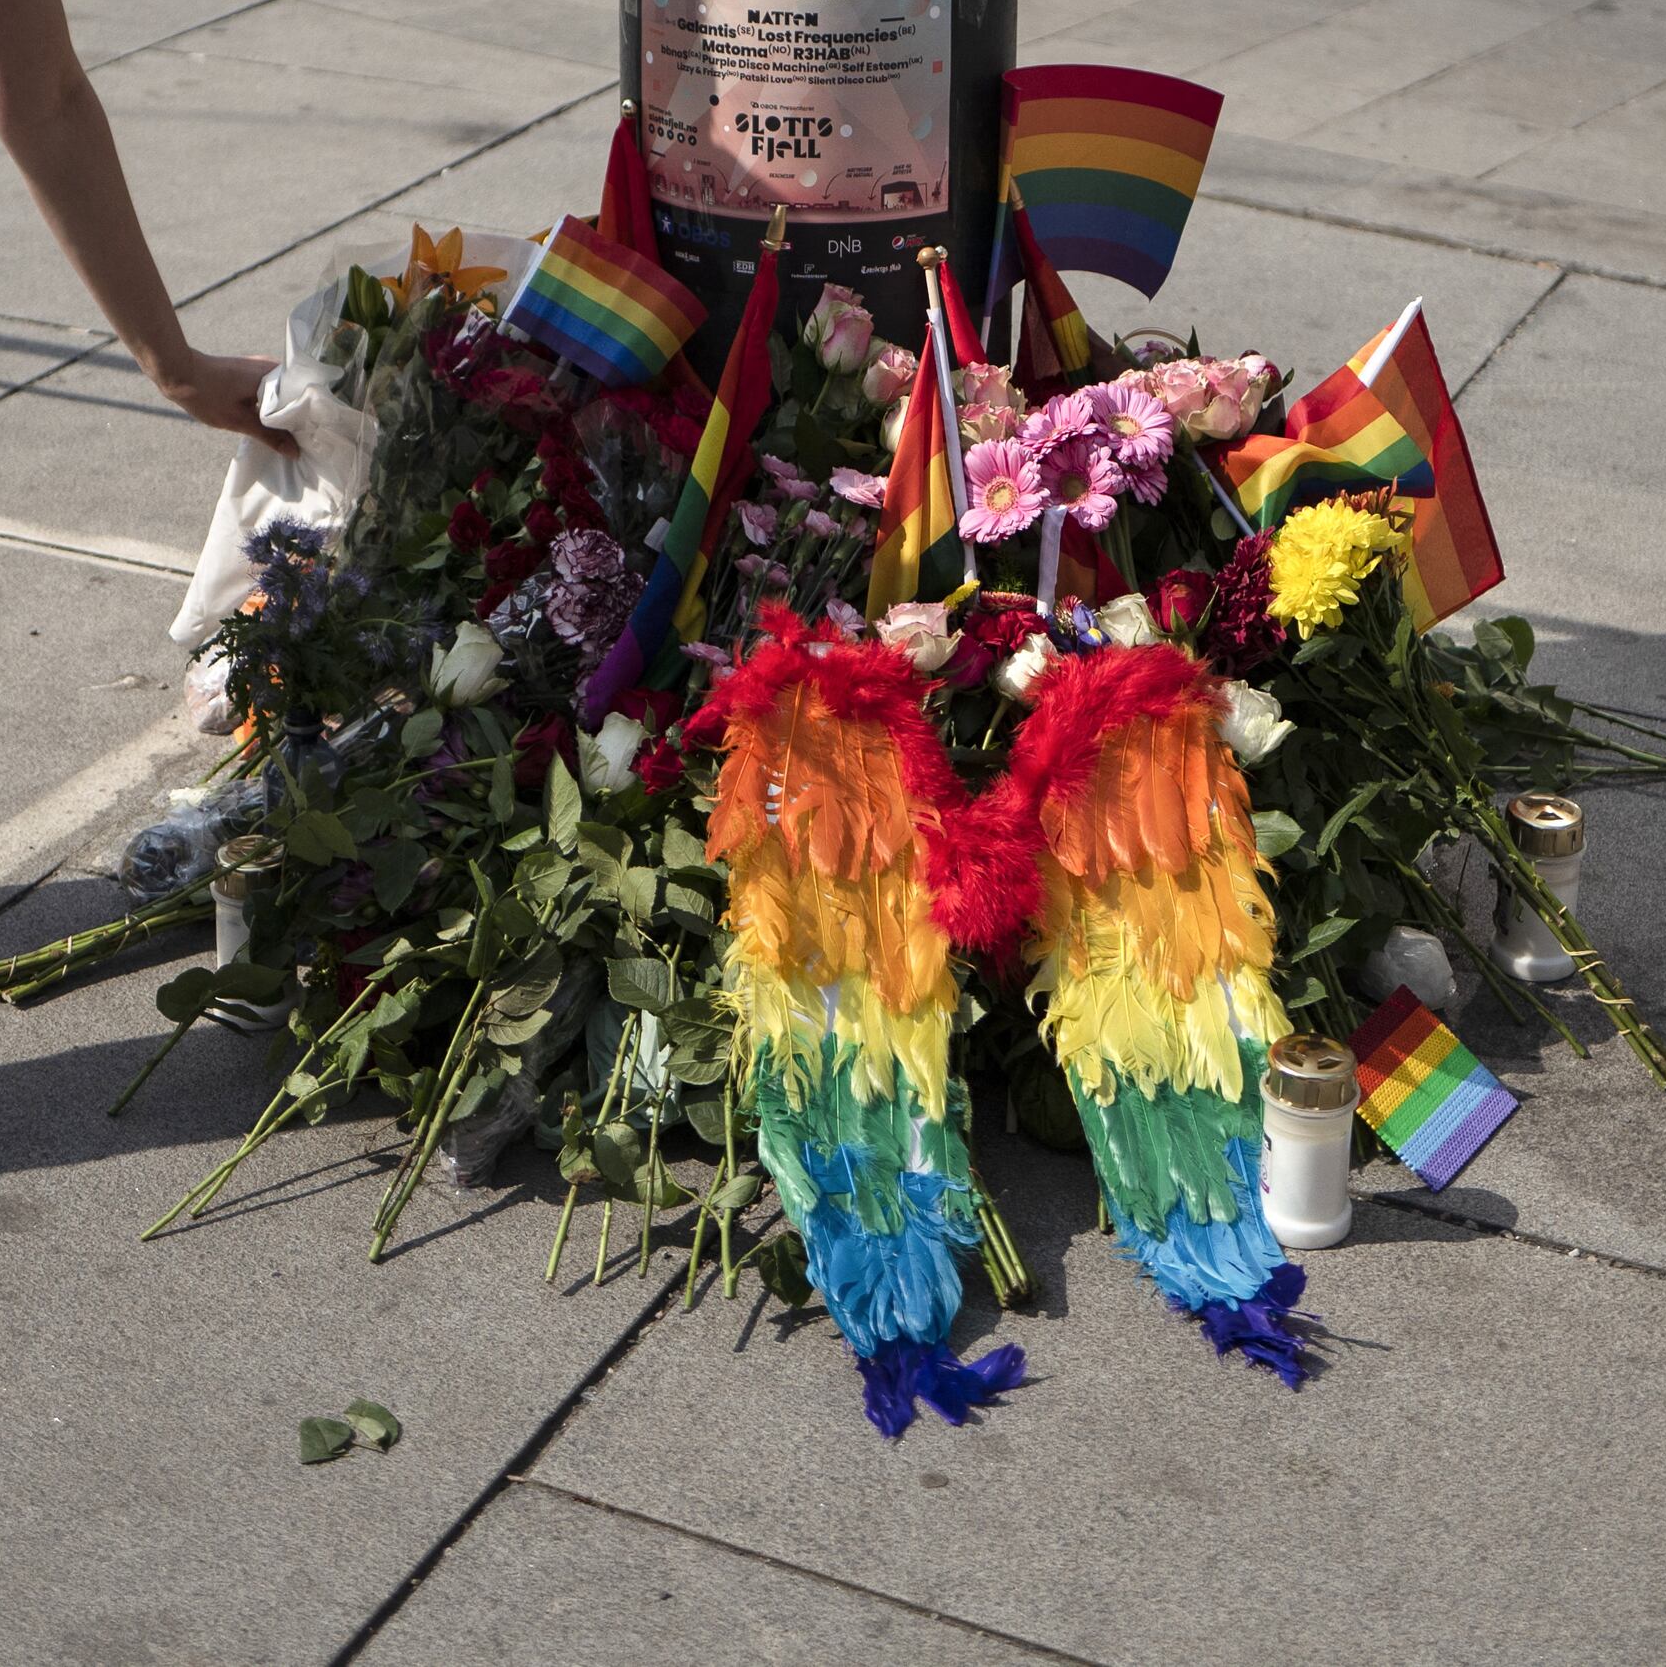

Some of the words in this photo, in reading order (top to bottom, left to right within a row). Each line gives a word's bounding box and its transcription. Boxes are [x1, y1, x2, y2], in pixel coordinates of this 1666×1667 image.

[757, 28, 792, 44] Lost
[701, 53, 737, 69] Purple
[738, 58, 771, 71] Disco
[841, 61, 865, 74] Self
[808, 76, 836, 85] Silent
[837, 76, 865, 85] Disco
[735, 112, 833, 138] SLOTTS
[751, 135, 822, 163] FJELL
[828, 235, 863, 259] DNB
